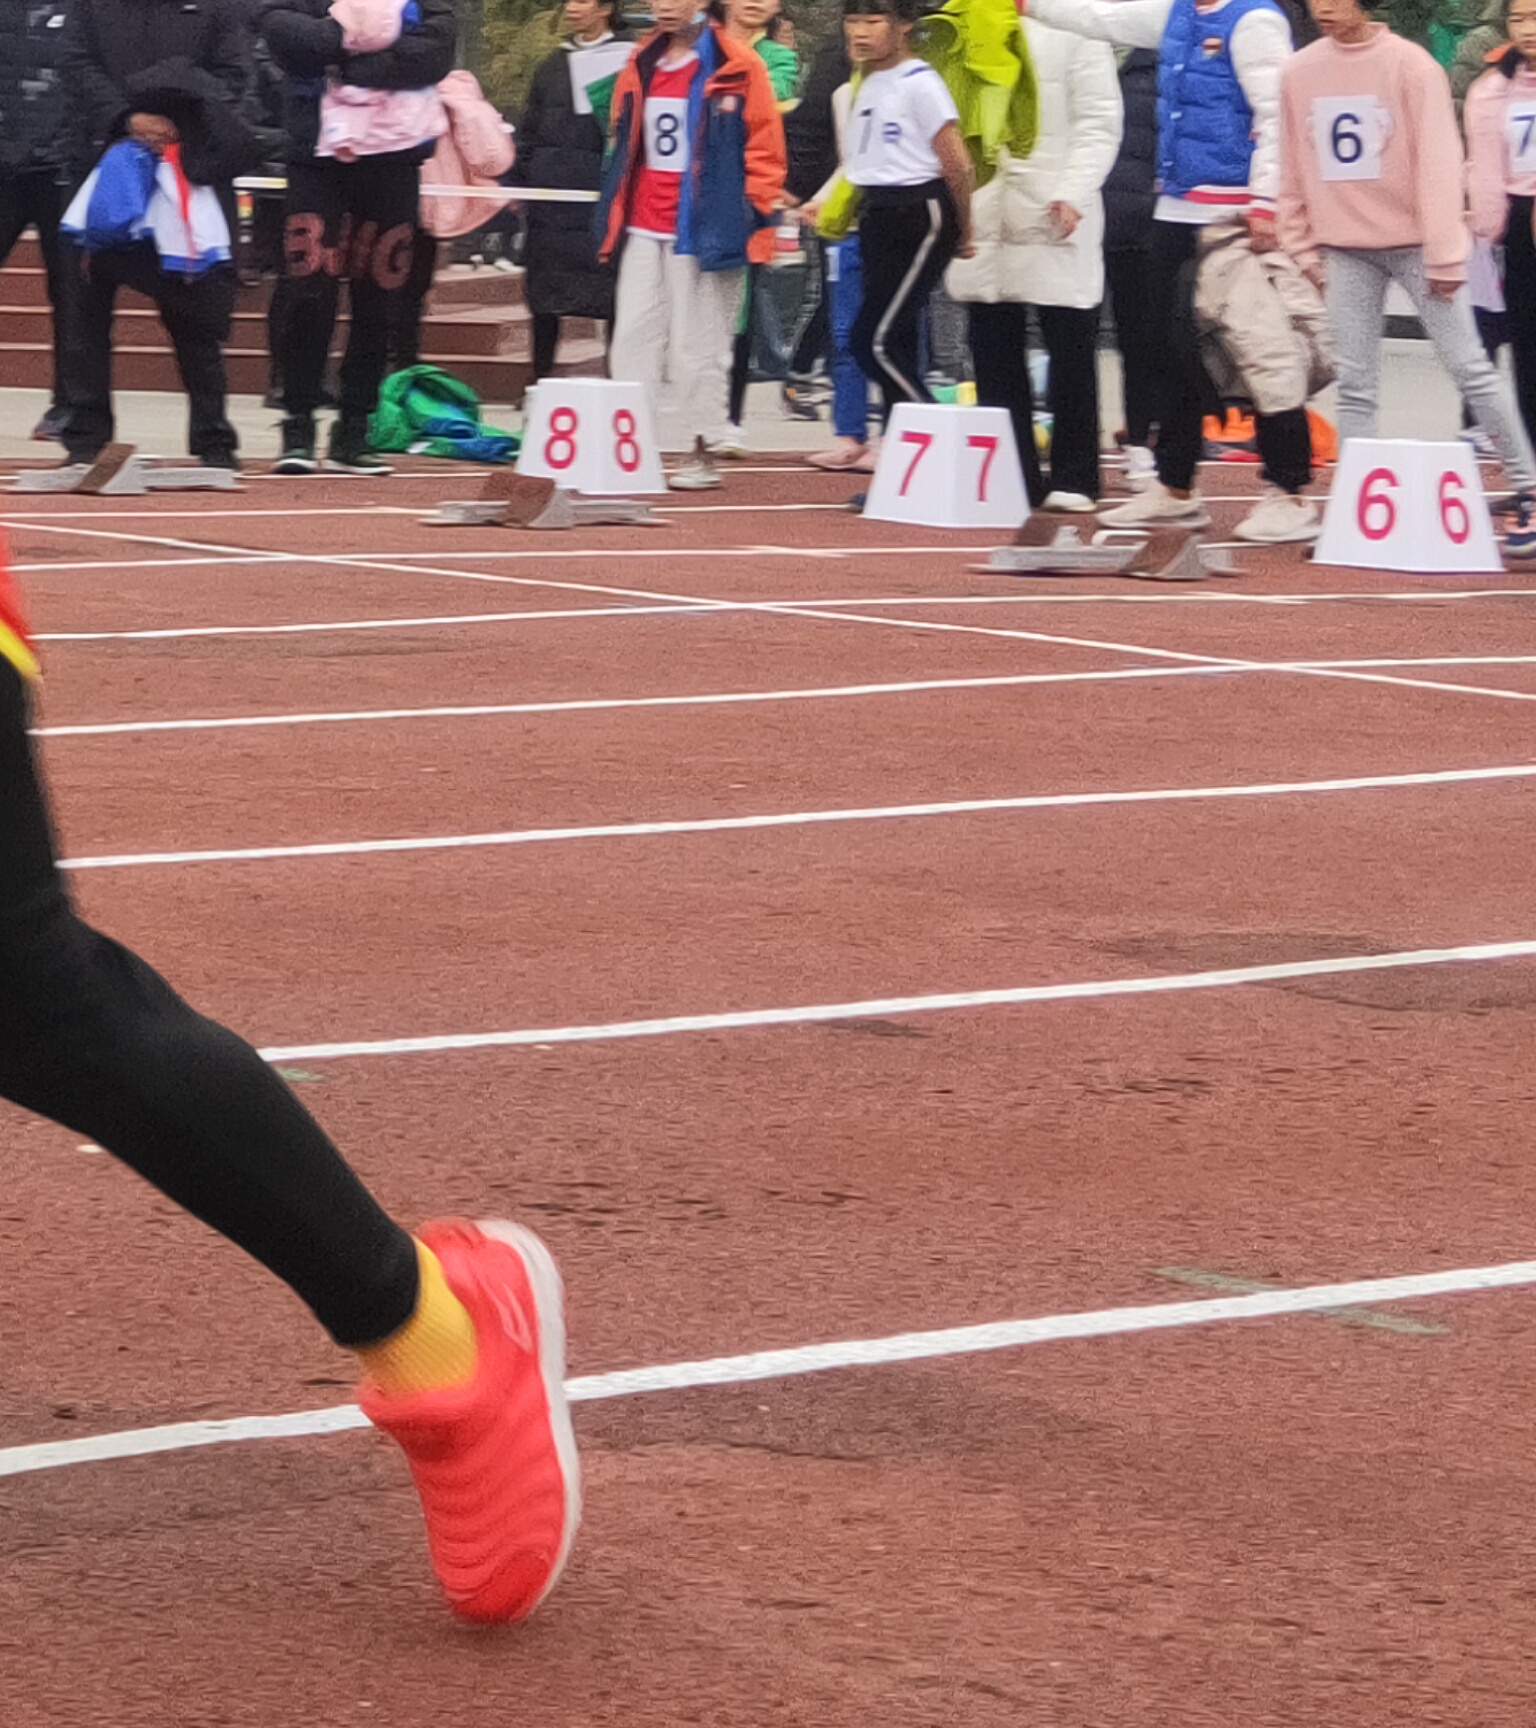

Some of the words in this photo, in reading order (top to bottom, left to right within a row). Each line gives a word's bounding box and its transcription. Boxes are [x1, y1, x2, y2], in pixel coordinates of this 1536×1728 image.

[655, 113, 679, 157] 8
[1330, 112, 1363, 164] 6
[1512, 114, 1536, 158] 7
[544, 406, 578, 470] 8
[613, 409, 641, 473] 8
[899, 430, 933, 497] 7
[967, 435, 999, 502] 7
[1357, 467, 1400, 541] 6
[1439, 470, 1471, 545] 6
